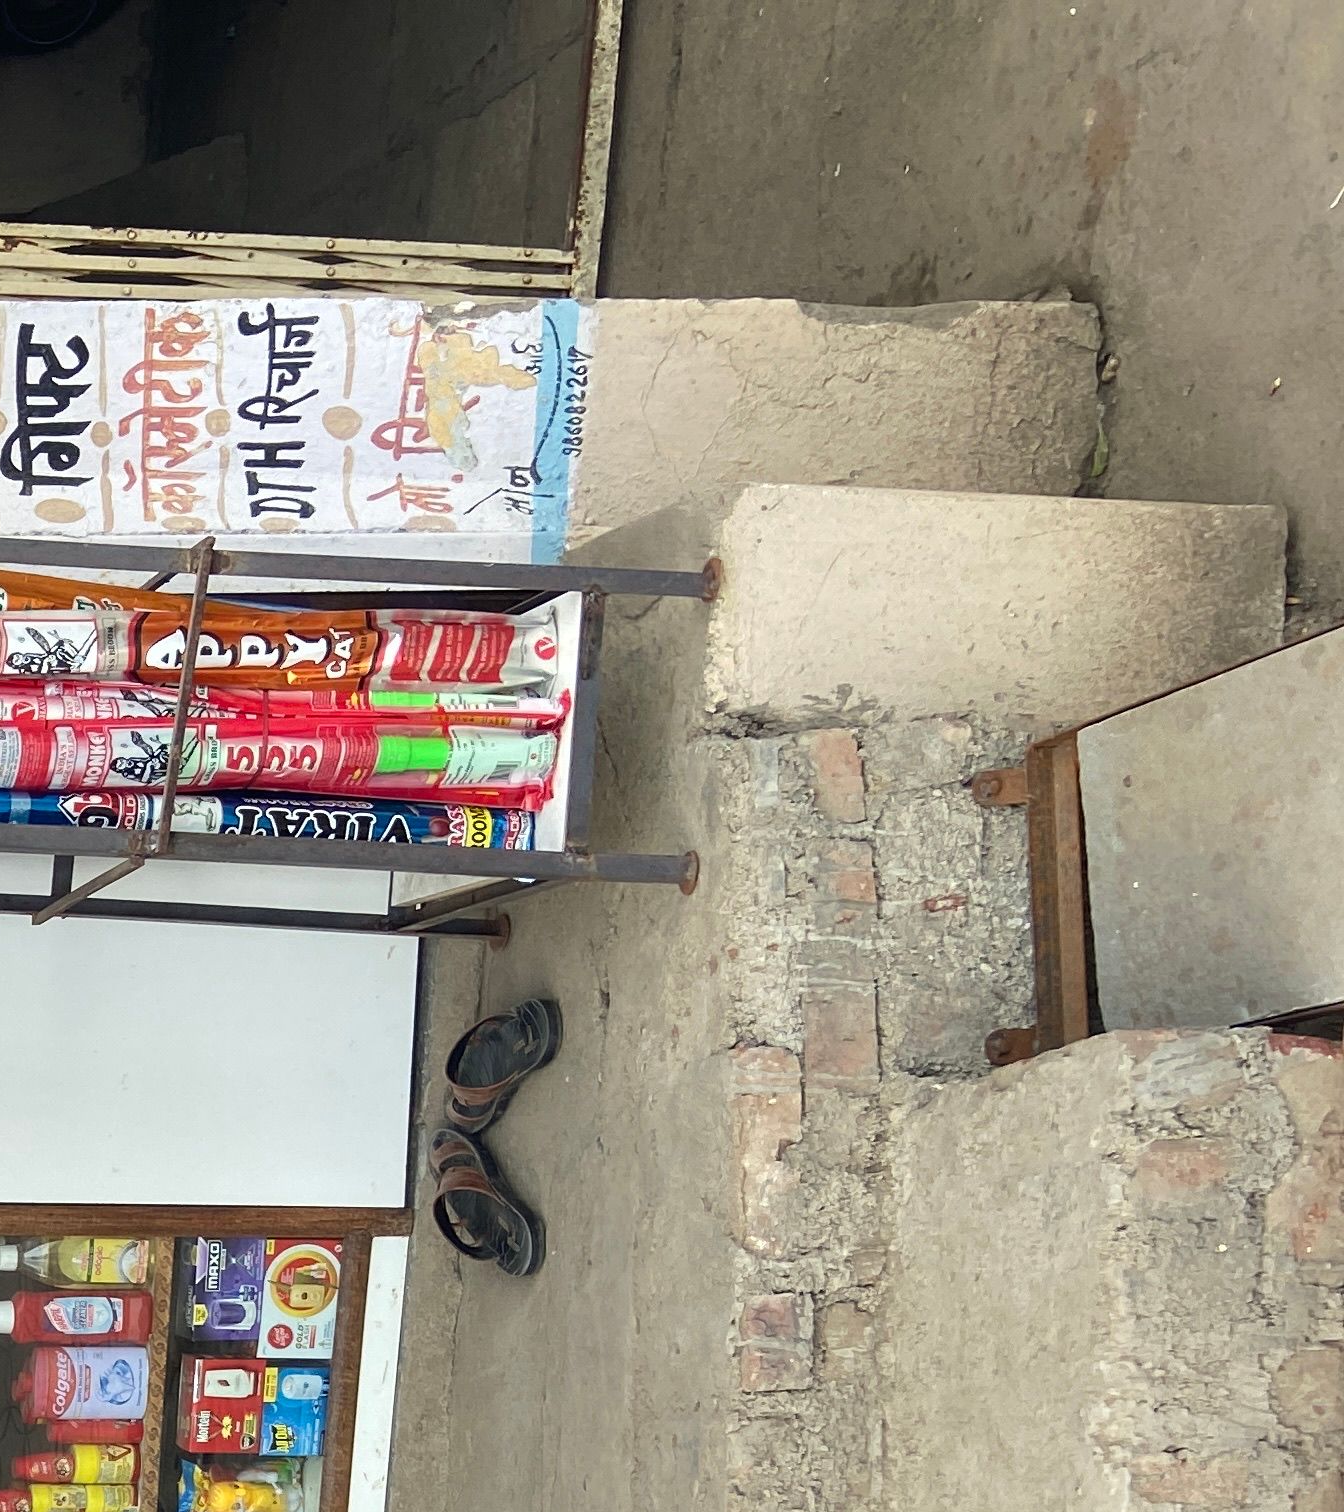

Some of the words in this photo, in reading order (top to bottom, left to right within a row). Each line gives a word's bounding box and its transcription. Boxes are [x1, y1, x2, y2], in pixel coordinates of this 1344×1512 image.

[238, 303, 319, 429] रिचार्ज
[0, 323, 94, 496] गिफ्ट
[118, 308, 213, 522] कॉस्मेटीक
[237, 440, 317, 519] DTH
[325, 627, 355, 679] CAT
[85, 732, 106, 786] MONKEY
[208, 1243, 219, 1289] MAXO
[52, 1351, 70, 1415] Colgate
[196, 1410, 211, 1442] Mortein
[274, 1424, 287, 1440] Out
[276, 1441, 288, 1453] All
